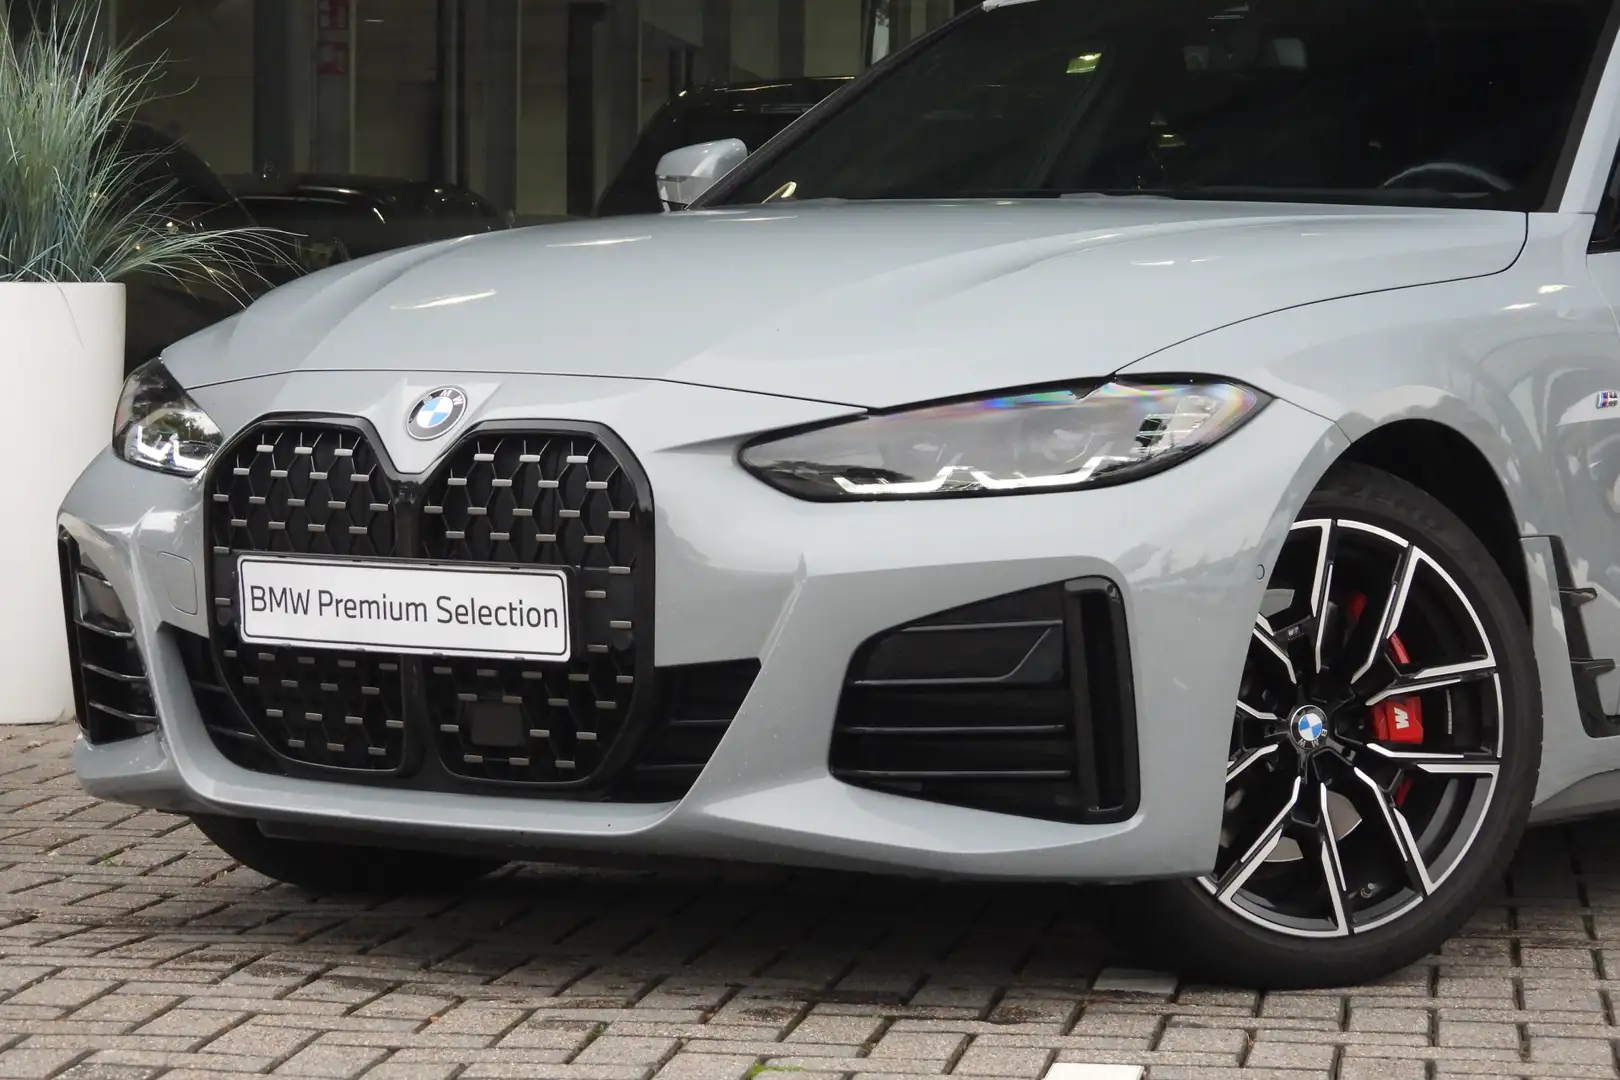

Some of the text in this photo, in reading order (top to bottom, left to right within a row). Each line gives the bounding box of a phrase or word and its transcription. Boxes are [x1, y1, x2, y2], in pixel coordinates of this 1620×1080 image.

[250, 585, 559, 628] BMW Premium Selection
